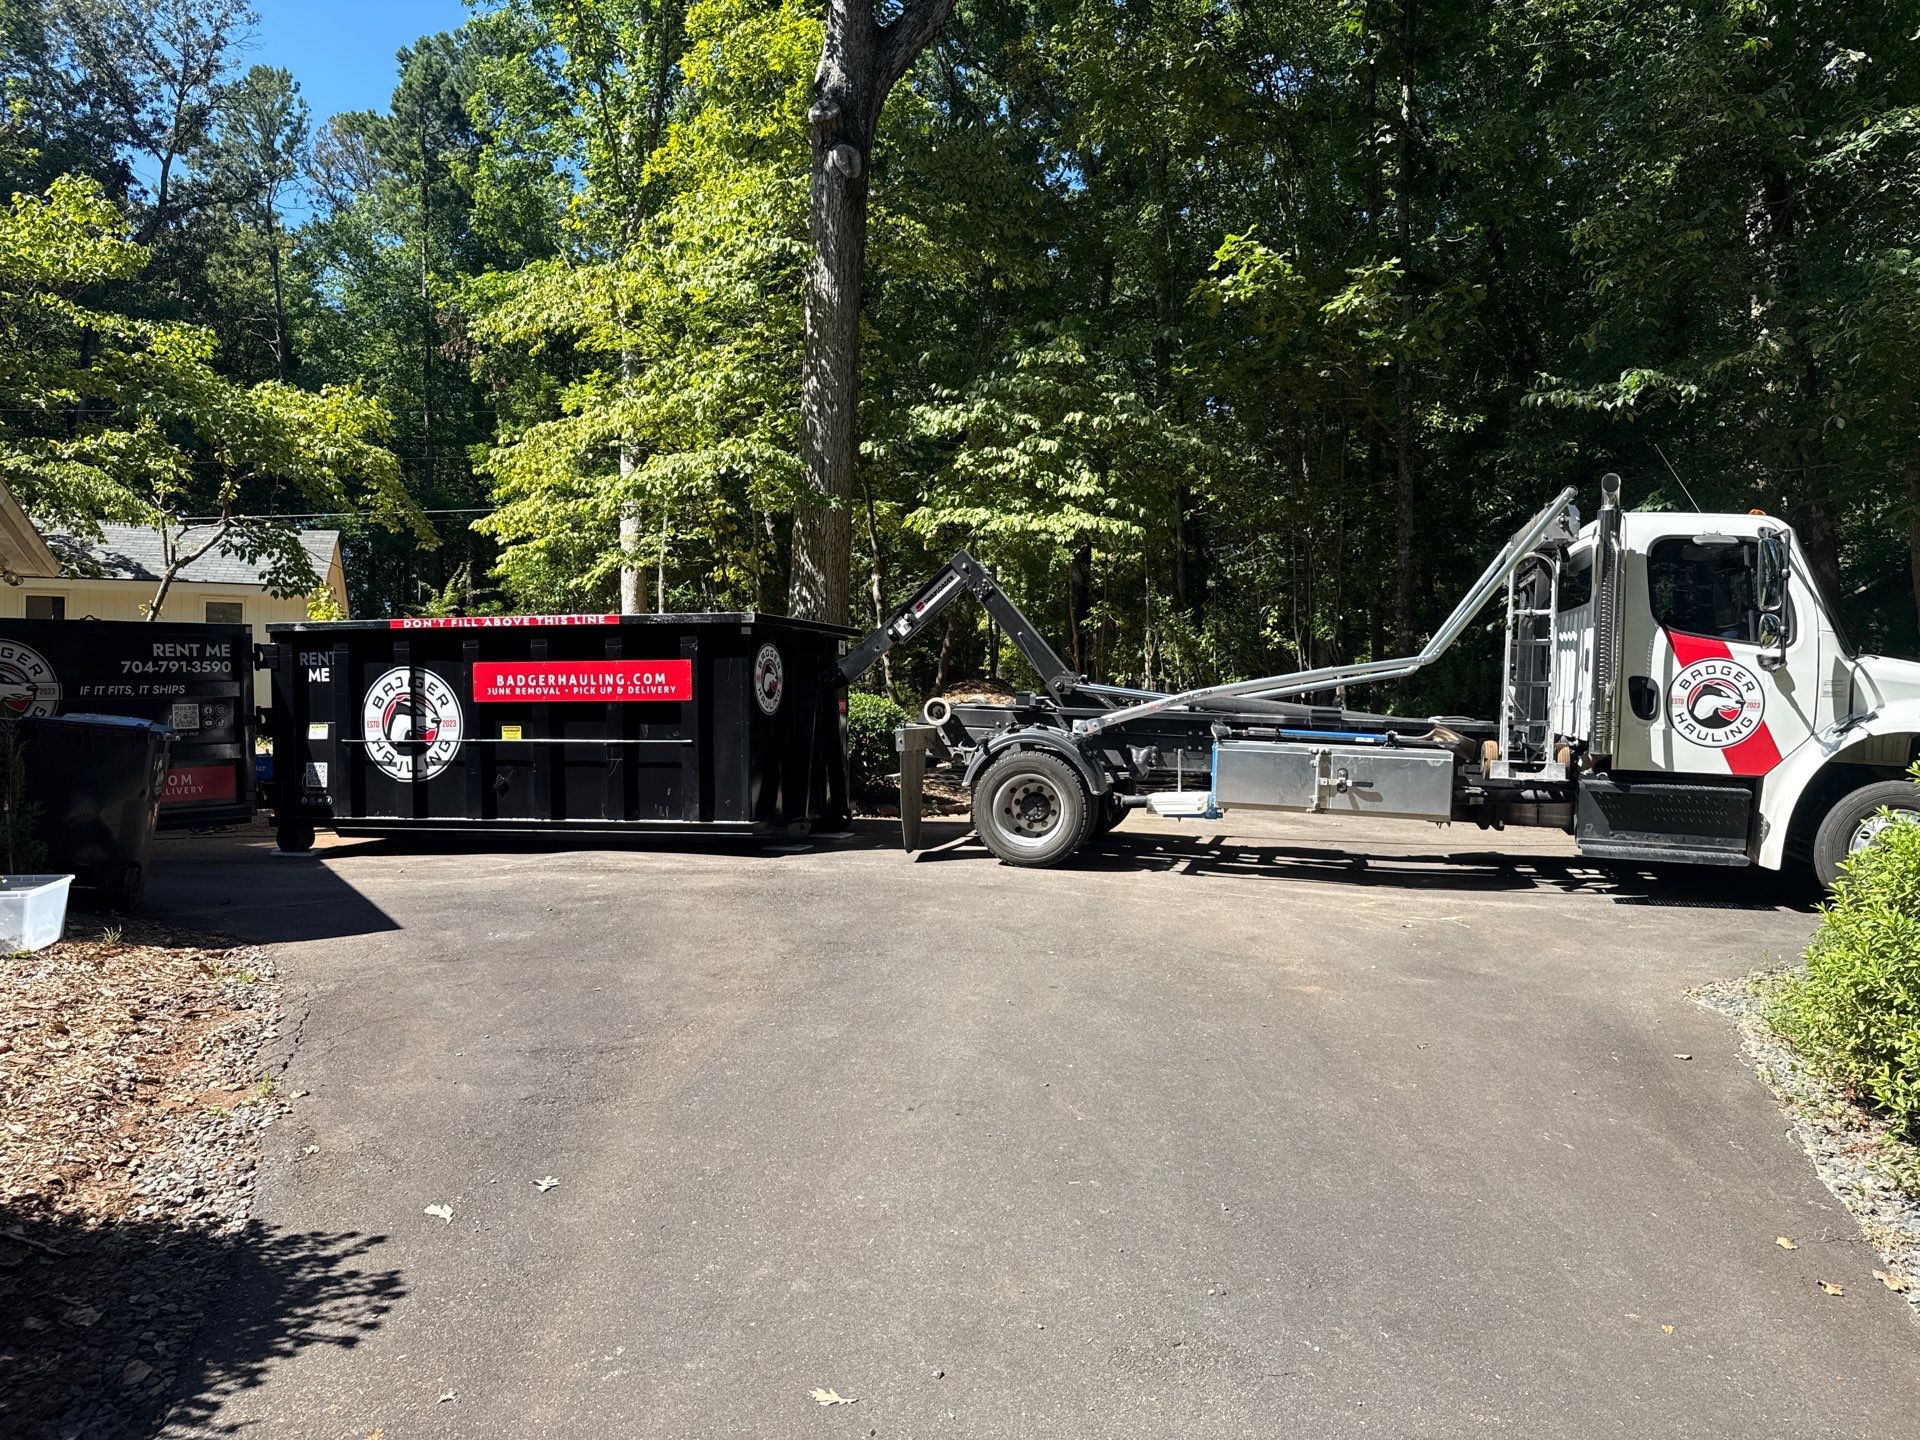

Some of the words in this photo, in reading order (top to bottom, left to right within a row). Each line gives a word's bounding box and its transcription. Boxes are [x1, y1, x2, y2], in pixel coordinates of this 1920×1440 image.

[403, 619, 446, 628] DON'T
[451, 618, 478, 627] FILL
[484, 617, 530, 627] ABOVE
[536, 616, 567, 625] THIS
[574, 615, 605, 625] LINE
[152, 643, 200, 657] RENT
[205, 643, 231, 657] ME
[0, 646, 44, 677] GER
[299, 651, 335, 666] RENT
[121, 660, 232, 674] 704-791-3590
[308, 667, 330, 682] ME
[496, 673, 666, 686] BADGERHAULING.COM
[1678, 665, 1756, 694] BADGER
[80, 686, 91, 695] IF
[94, 685, 105, 695] IT
[108, 685, 135, 696] FITS,
[139, 685, 150, 694] IT
[152, 684, 186, 695] SHIPS
[487, 687, 511, 695] JUNK
[515, 687, 560, 695] REMOVAL
[573, 686, 596, 694] PICK
[600, 686, 612, 694] UP
[616, 686, 624, 694] &
[627, 685, 676, 694] DELIVERY
[367, 720, 380, 728] ESTD
[442, 719, 457, 728] 2023
[1675, 711, 1754, 743] HAULING
[162, 785, 204, 796] LIVERY
